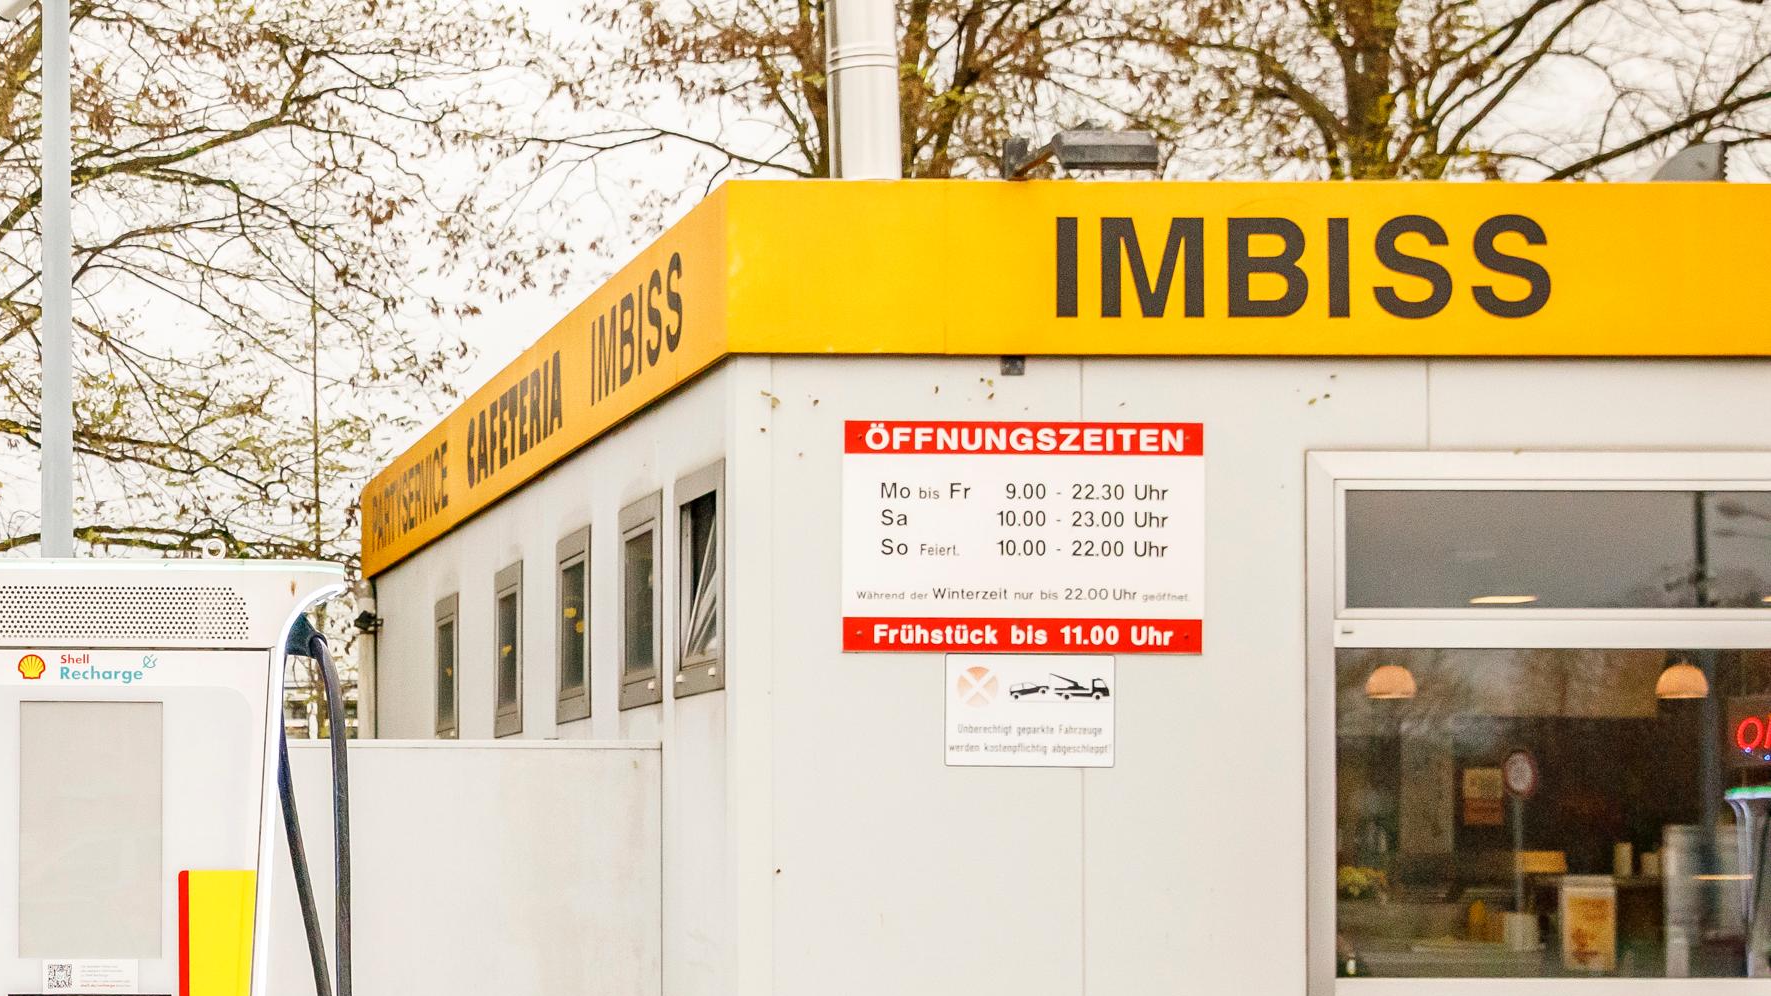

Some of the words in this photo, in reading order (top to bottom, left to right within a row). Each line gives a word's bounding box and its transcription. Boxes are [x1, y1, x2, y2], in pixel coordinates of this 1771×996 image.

[1055, 214, 1551, 320] IMBISS
[372, 440, 448, 552] PARTYSERVICE
[467, 350, 563, 489] CAFETERIA
[590, 251, 683, 406] IMBISS
[864, 422, 1185, 452] ÖFFNUNGSZEITEN
[880, 482, 911, 500] Mo
[918, 486, 940, 500] bis
[949, 482, 971, 500] Fr
[1005, 483, 1047, 501] 9.00
[1071, 483, 1125, 502] 22.30
[1134, 483, 1168, 502] Uhr
[880, 509, 908, 527] Sa
[997, 511, 1047, 528] 10.00
[1071, 511, 1125, 529] 23.00
[1134, 511, 1168, 529] Uhr
[880, 538, 909, 556] So
[997, 540, 1047, 557] 10.00
[1071, 540, 1125, 558] 22.00
[1134, 540, 1168, 558] Uhr
[856, 589, 905, 600] Während
[910, 590, 928, 600] der
[932, 587, 1008, 601] Winterzeit
[1013, 590, 1034, 601] nur
[1039, 589, 1059, 601] bis
[1112, 587, 1137, 602] Uhr
[873, 623, 998, 645] Frühstück
[1011, 625, 1048, 645] bis
[1060, 626, 1120, 646] 11.00
[1130, 626, 1174, 647] Uhr
[60, 654, 89, 664] Shell
[60, 666, 143, 684] Recharge
[957, 724, 1012, 736] Unberechtigt
[1016, 725, 1055, 736] geparkte
[1058, 724, 1103, 737] Fahrzeuge
[949, 744, 980, 753] werden
[983, 744, 1048, 755] kostenpflichtig
